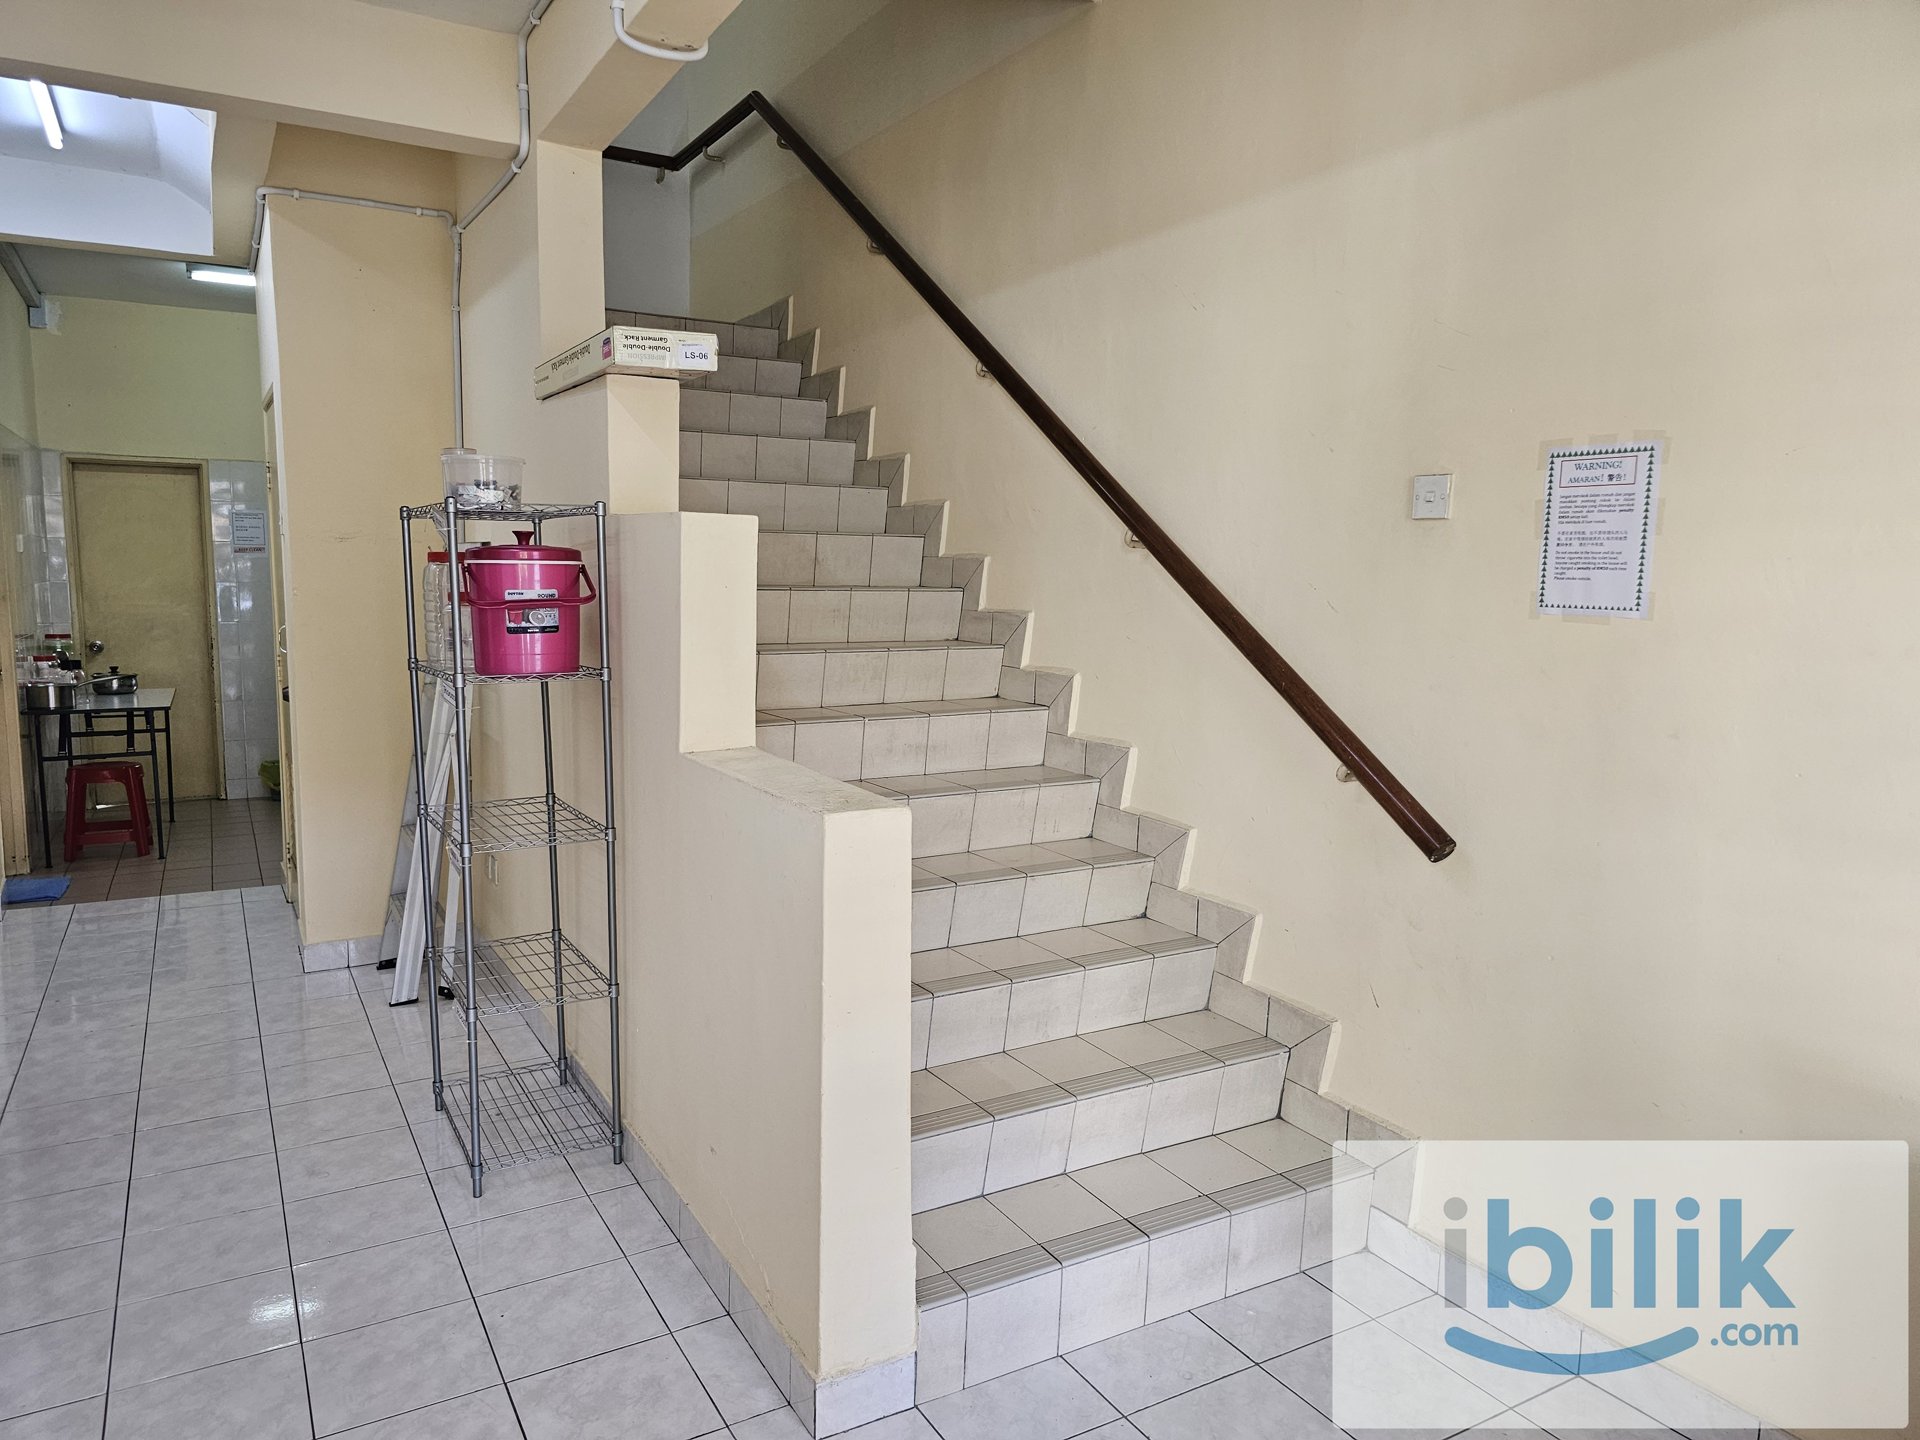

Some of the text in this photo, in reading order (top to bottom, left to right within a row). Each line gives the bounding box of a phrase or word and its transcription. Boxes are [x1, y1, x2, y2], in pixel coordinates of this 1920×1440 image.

[640, 336, 668, 344] Garment
[622, 343, 671, 353] Double-Double
[685, 351, 709, 361] LS-06
[1574, 461, 1622, 470] WARNING!
[1568, 474, 1604, 484] AMARAN!
